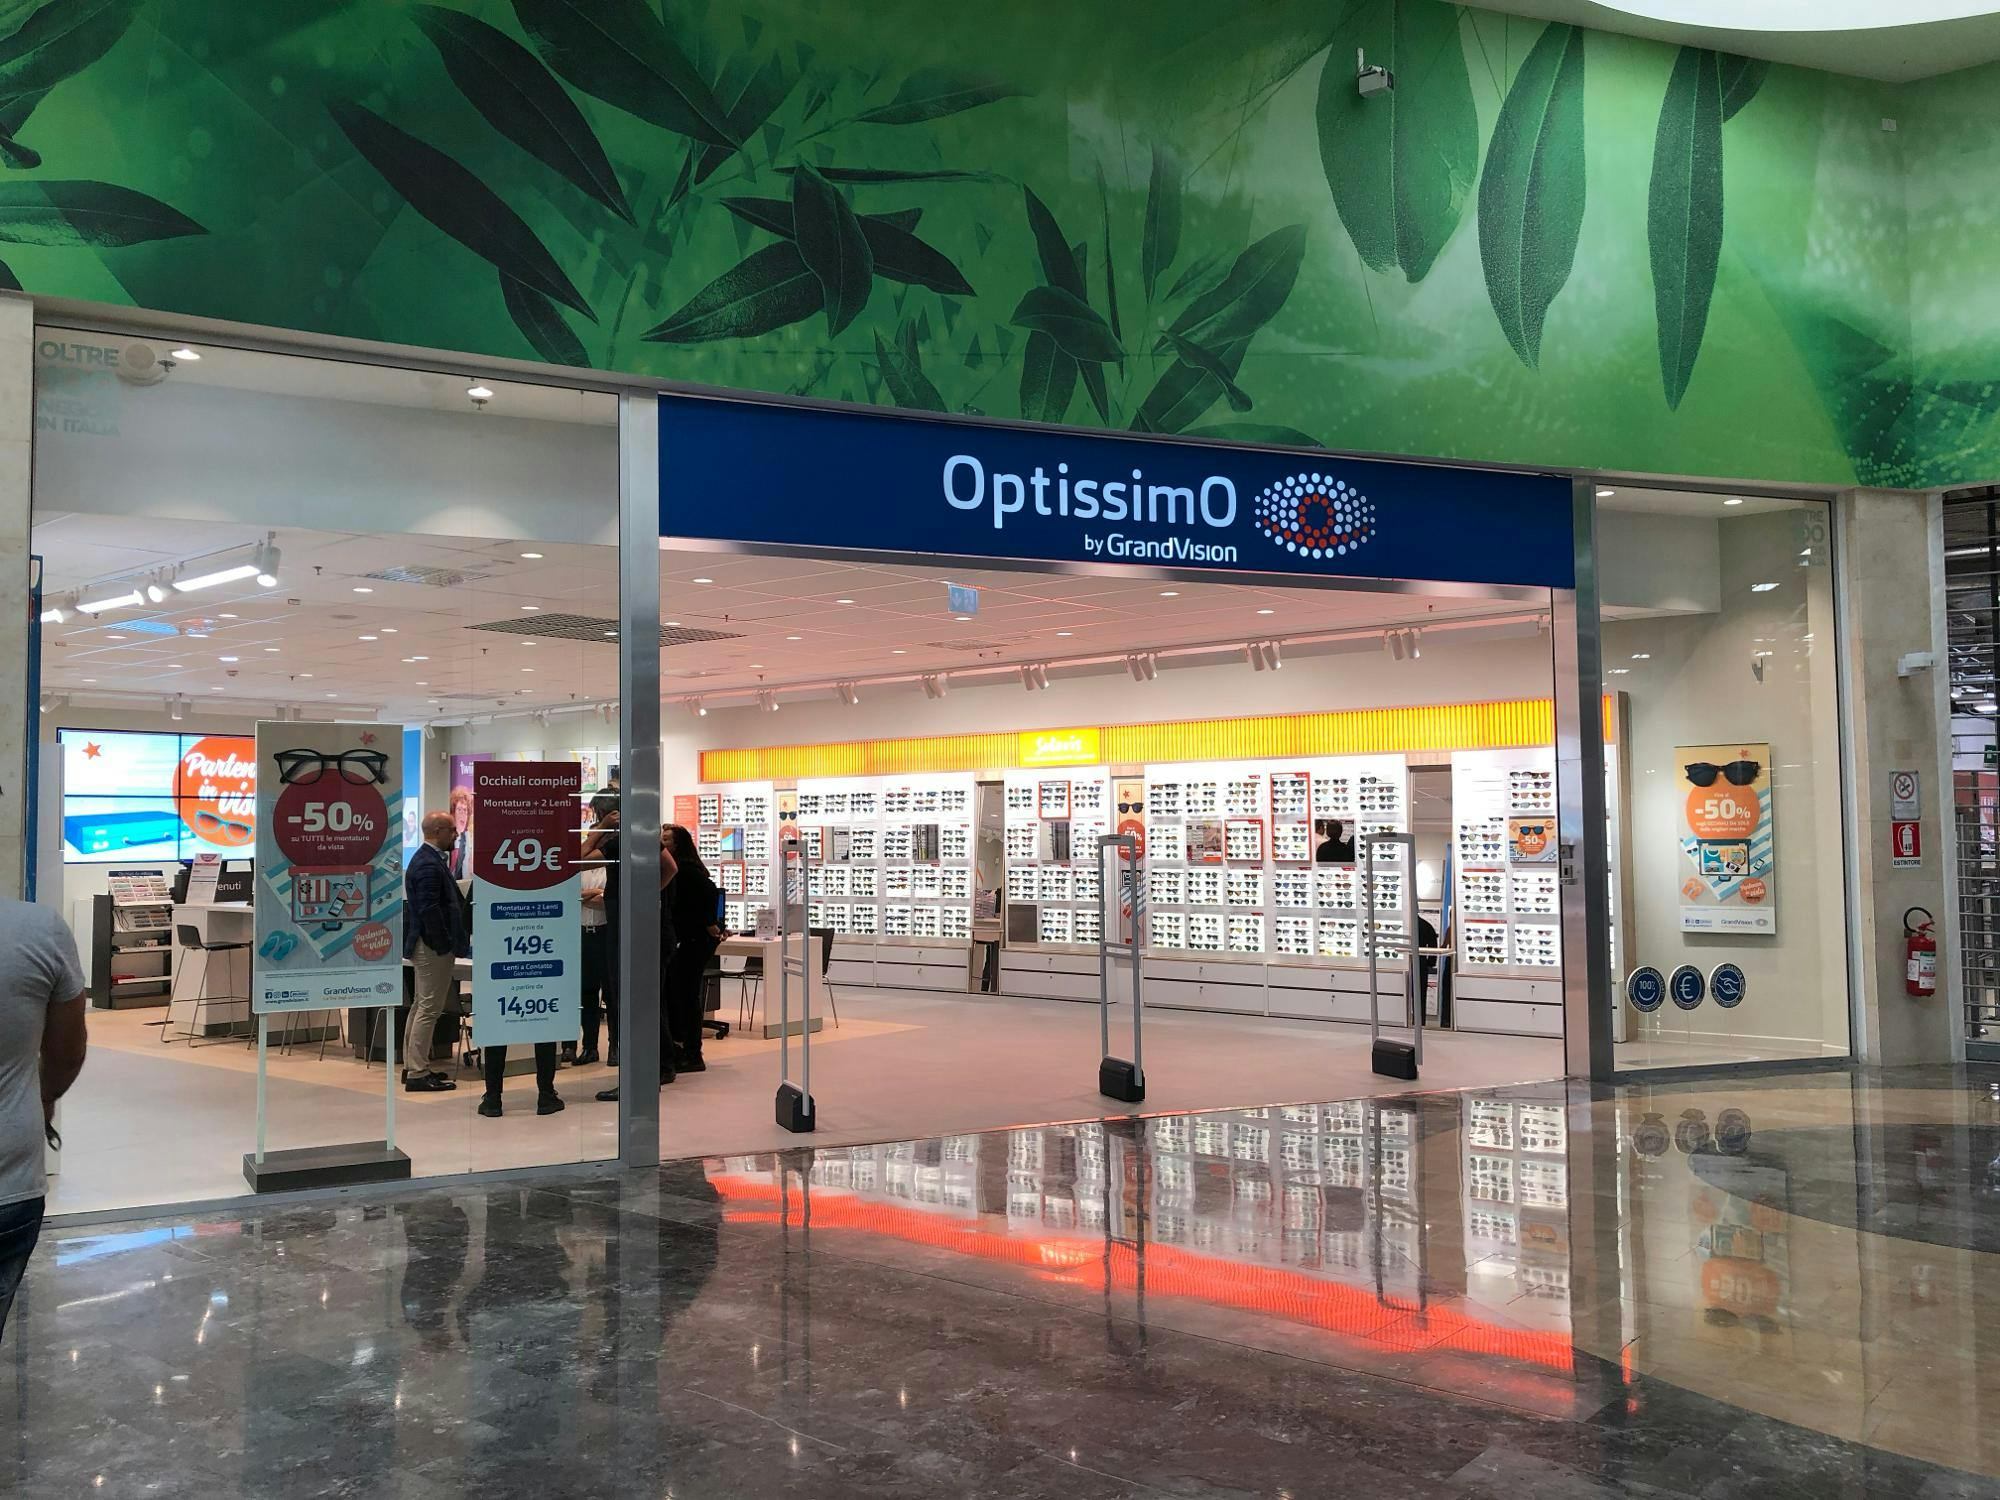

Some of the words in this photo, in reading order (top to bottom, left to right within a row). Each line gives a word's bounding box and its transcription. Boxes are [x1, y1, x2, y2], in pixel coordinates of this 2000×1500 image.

[39, 341, 119, 367] OLTRE
[942, 454, 1238, 529] OptissimO
[1084, 533, 1103, 556] by
[1106, 532, 1238, 563] GrandVision
[198, 779, 217, 801] in
[480, 775, 526, 786] Occhiali
[528, 775, 577, 788] completi
[483, 799, 531, 807] Montatura
[549, 799, 572, 807] Lenti
[1694, 798, 1751, 819] -50%
[287, 801, 374, 832] -50%
[334, 833, 370, 841] montature
[492, 838, 562, 872] 49€
[503, 935, 554, 955] 149€
[323, 986, 371, 995] GrandVision
[497, 996, 559, 1018] 14,90€
